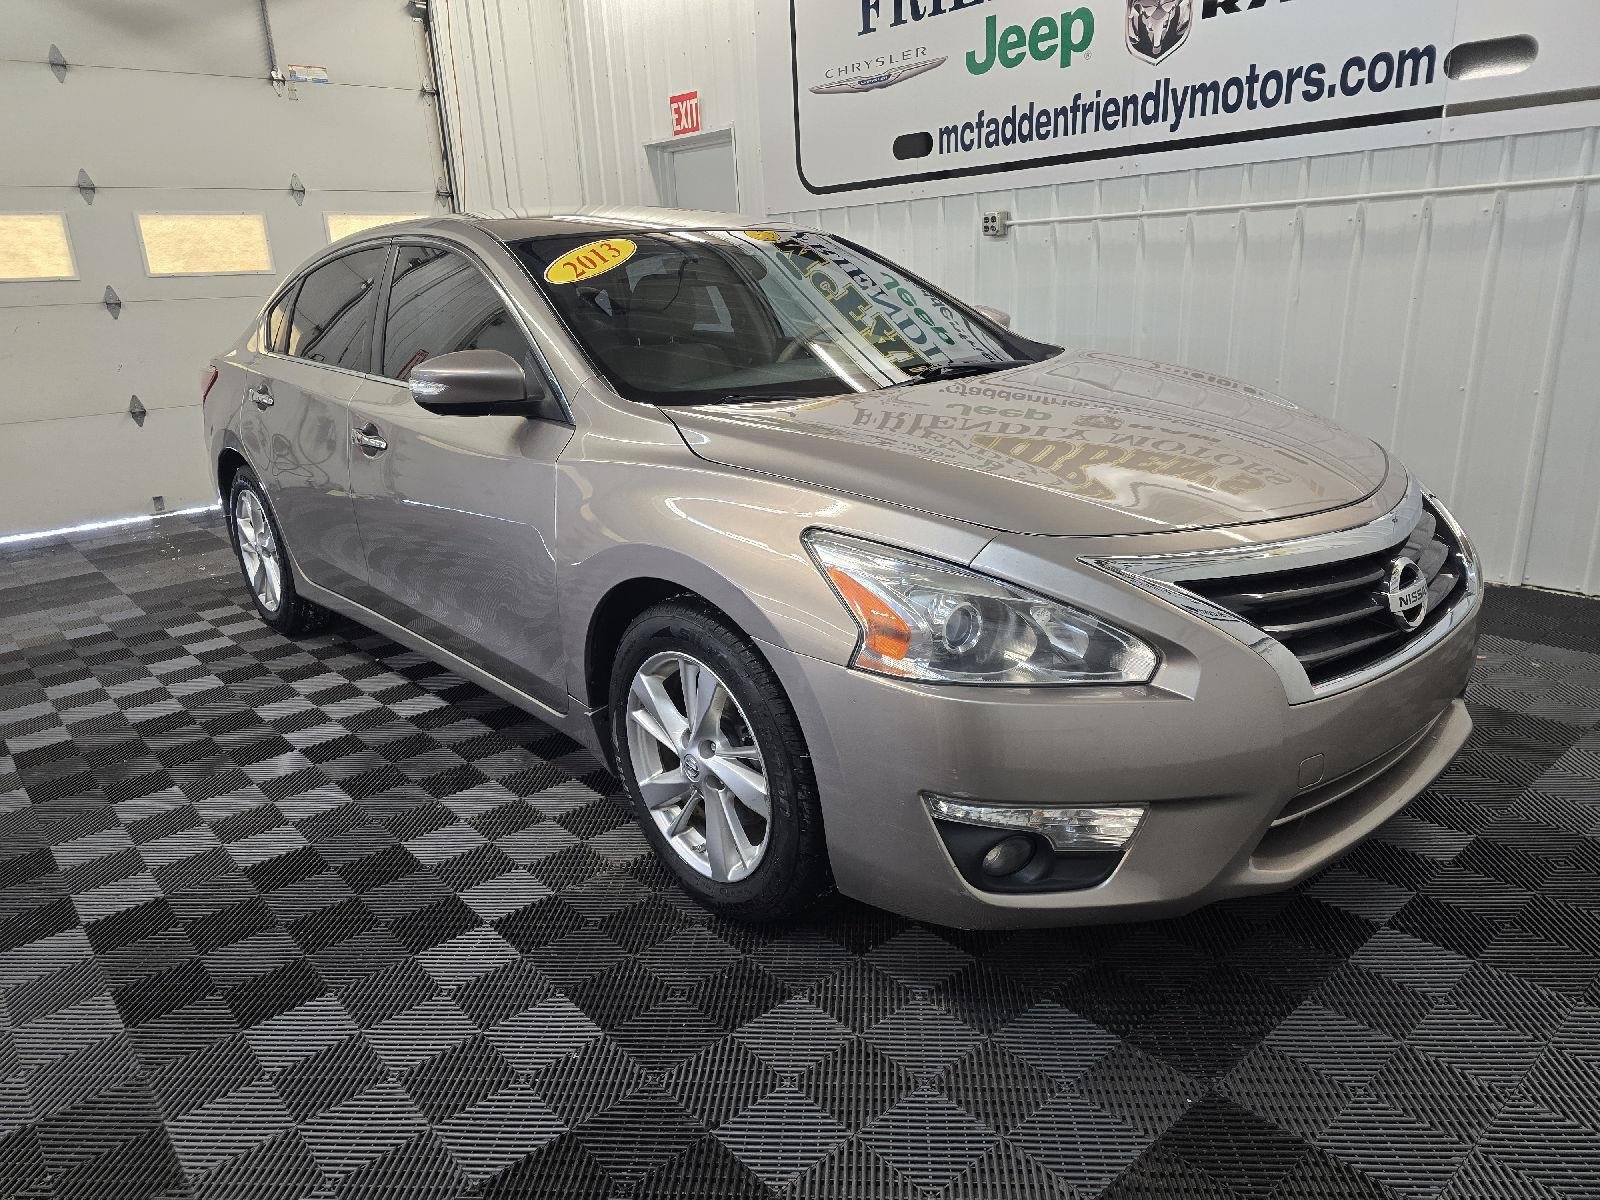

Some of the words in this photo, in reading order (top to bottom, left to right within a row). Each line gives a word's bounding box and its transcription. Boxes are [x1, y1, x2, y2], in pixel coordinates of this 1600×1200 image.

[965, 6, 1095, 76] Jeep
[824, 45, 928, 80] CHRYSLER
[670, 98, 698, 131] EXIT
[937, 44, 1437, 156] mcfaddenfriendlymotors.com
[562, 242, 621, 279] 2013
